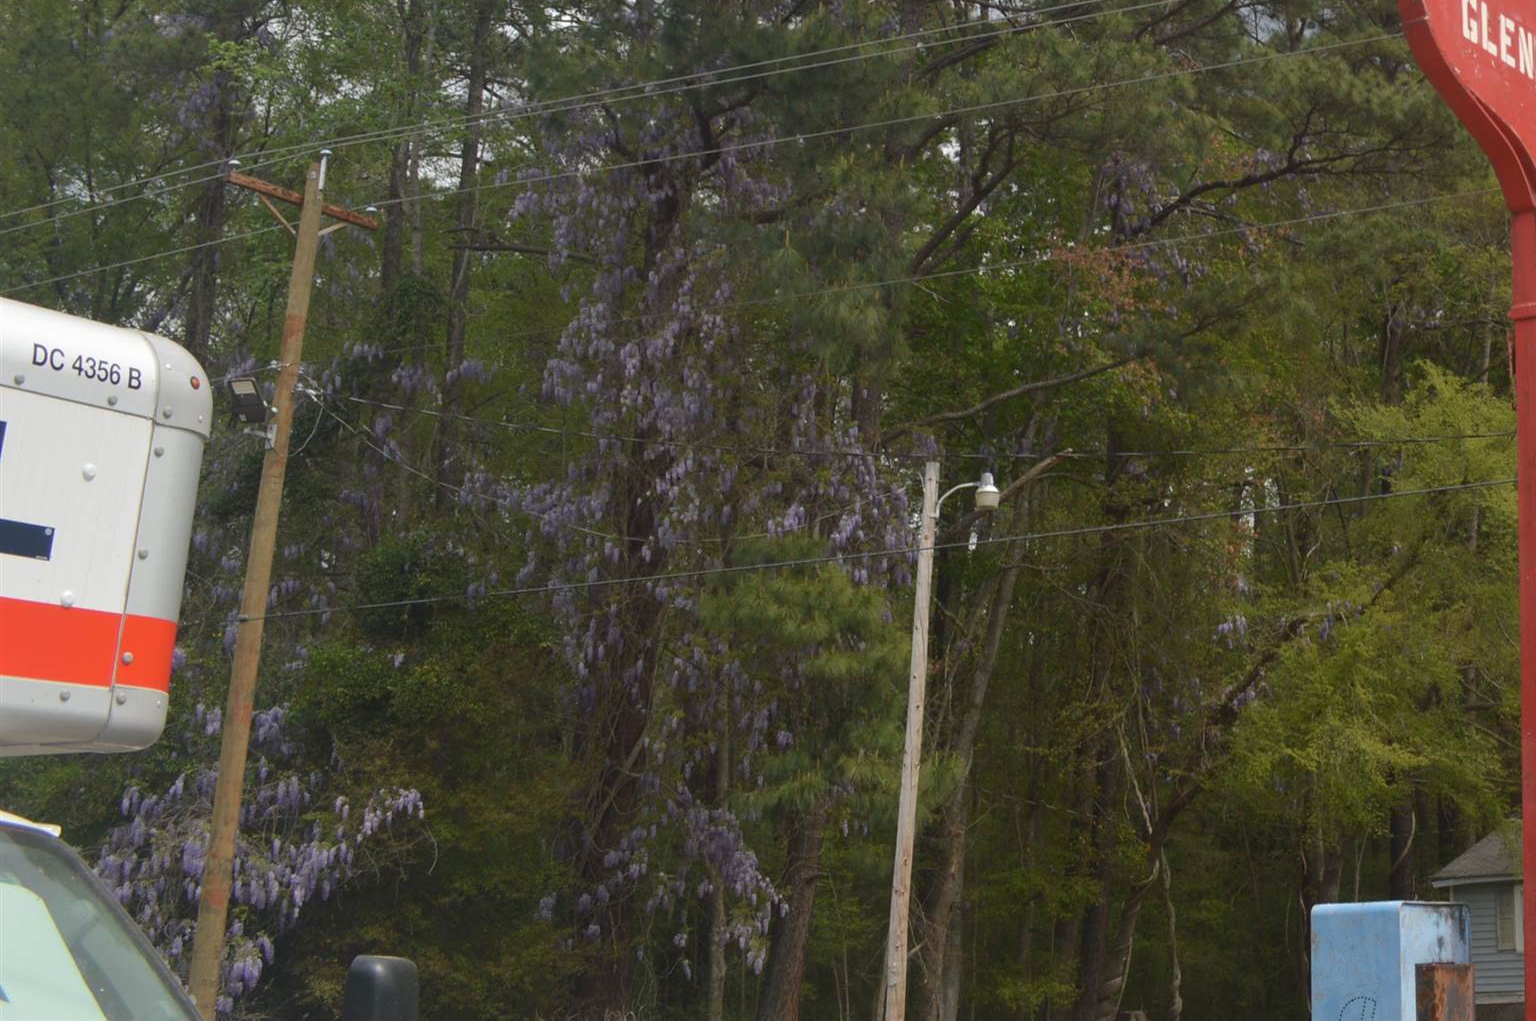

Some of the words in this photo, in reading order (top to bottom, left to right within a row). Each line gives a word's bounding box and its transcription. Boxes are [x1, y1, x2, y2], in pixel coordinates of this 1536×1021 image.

[32, 343, 65, 371] DC
[71, 354, 121, 386] 4356
[127, 366, 142, 390] B
